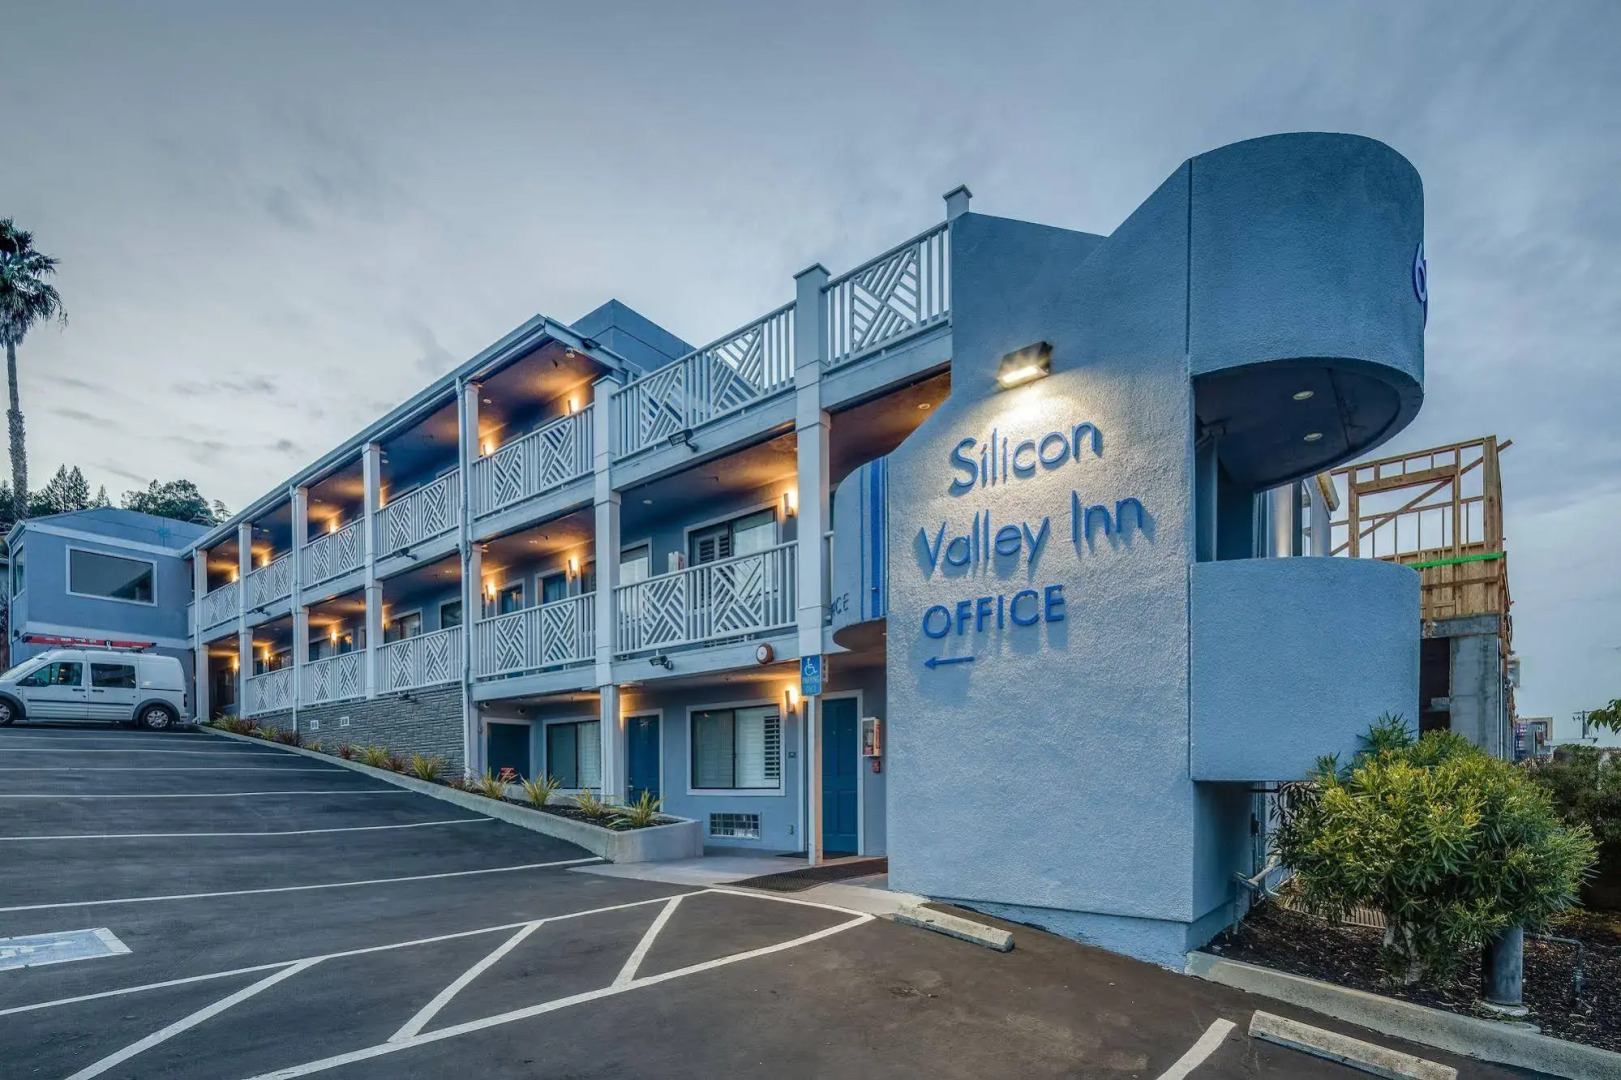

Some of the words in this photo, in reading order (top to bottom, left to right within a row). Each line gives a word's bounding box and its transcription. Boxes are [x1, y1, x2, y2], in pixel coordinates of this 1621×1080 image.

[952, 421, 1098, 487] Silicon
[921, 508, 1050, 567] Valley
[1071, 490, 1143, 543] Inn
[831, 592, 849, 615] CE
[922, 584, 1065, 639] OFFICE
